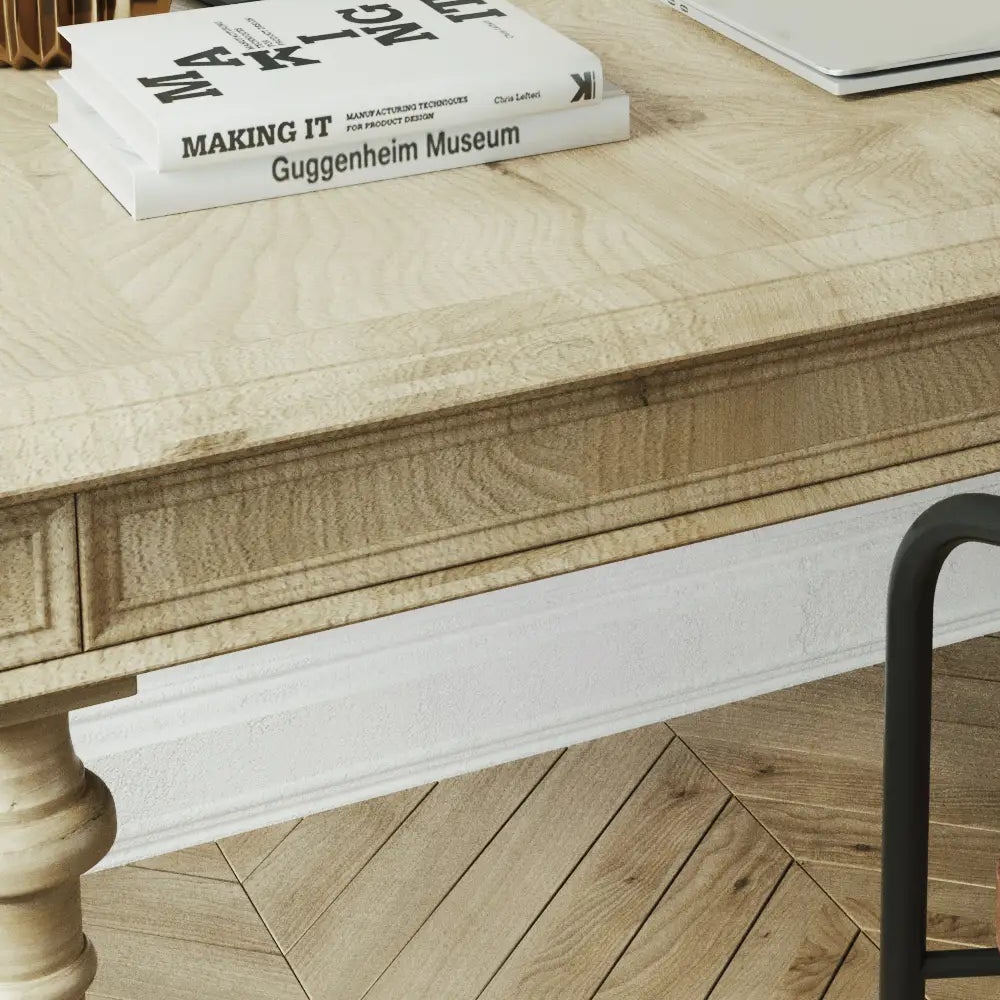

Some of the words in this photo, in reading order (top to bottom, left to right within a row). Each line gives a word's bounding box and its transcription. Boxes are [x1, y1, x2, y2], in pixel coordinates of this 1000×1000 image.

[345, 103, 418, 121] MANUFACTURING
[418, 95, 468, 111] TECHNIQUES
[494, 93, 514, 105] Chris
[346, 121, 363, 132] FOR
[365, 117, 402, 129] PRODUCT
[404, 111, 435, 123] DESIGN
[181, 121, 297, 159] MAKING
[304, 115, 333, 140] IT
[272, 138, 418, 184] Guggenheim
[426, 125, 520, 158] Museum
